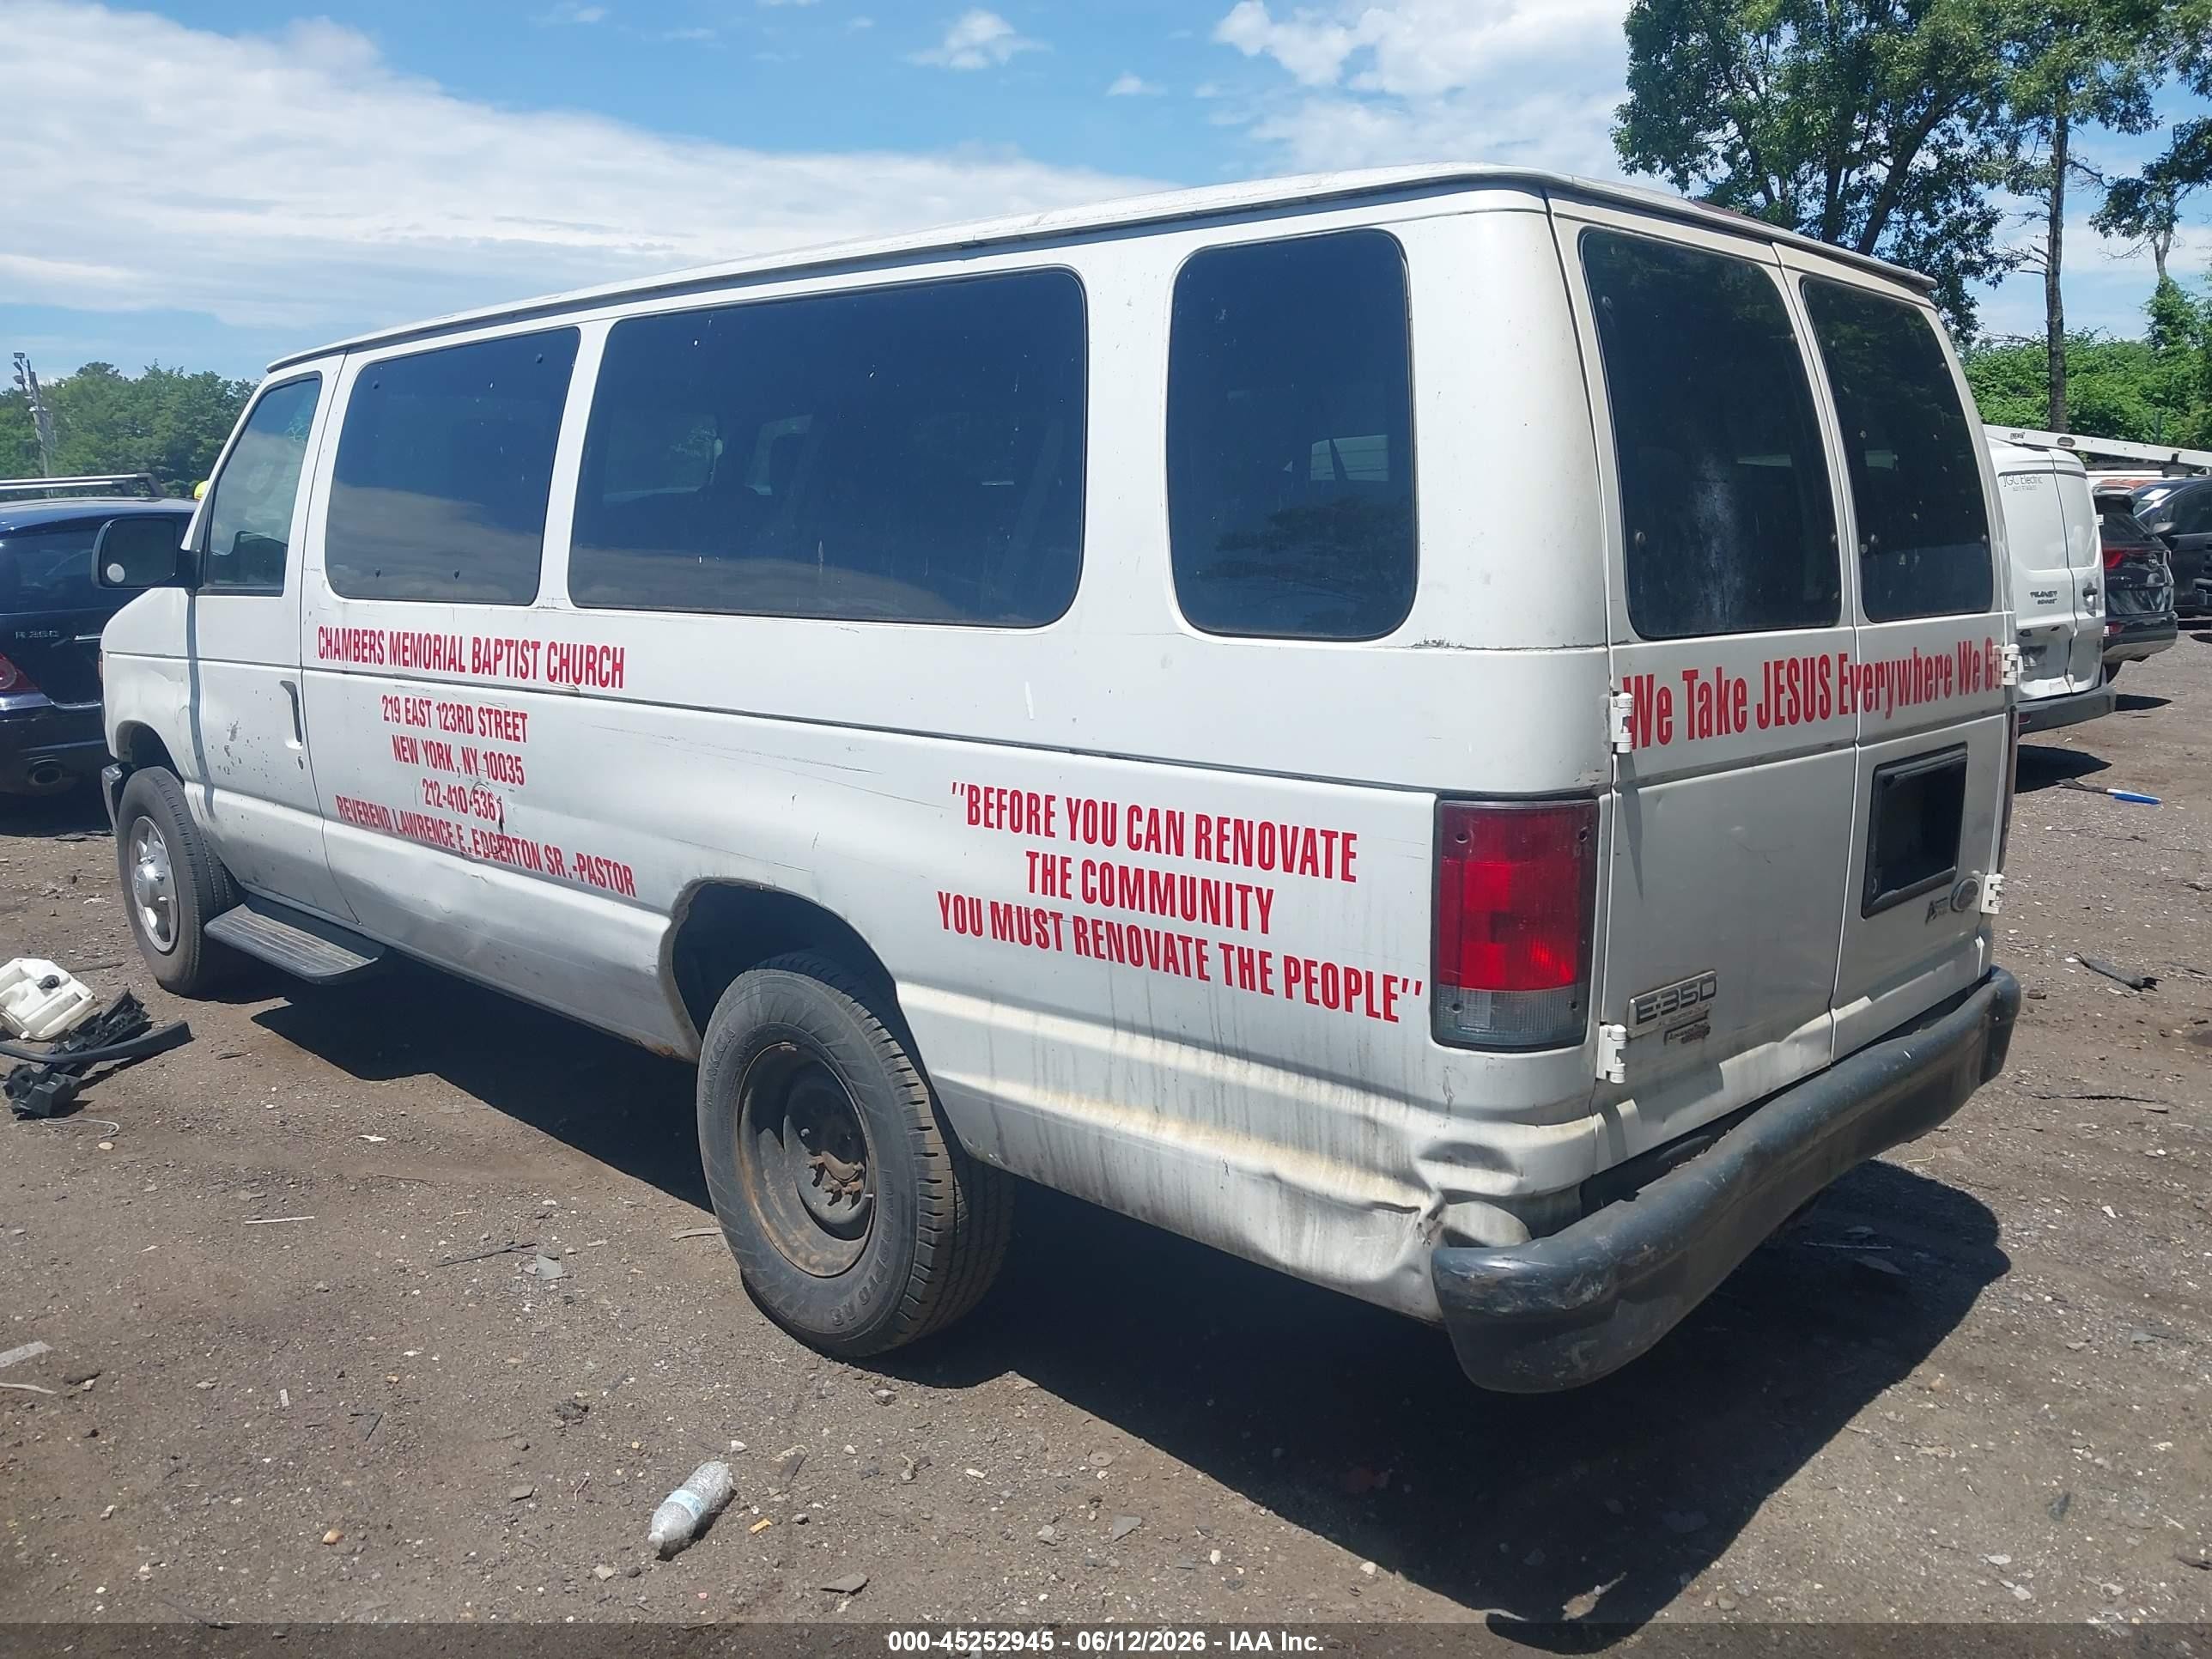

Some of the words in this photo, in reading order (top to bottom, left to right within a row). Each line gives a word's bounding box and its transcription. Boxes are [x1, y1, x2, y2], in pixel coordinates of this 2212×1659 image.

[318, 626, 385, 665] CHAMBERS
[389, 631, 465, 673] MEMORIAL
[471, 636, 540, 680] BAPTIST
[546, 641, 625, 688] CHURCH
[1623, 673, 1673, 750] We
[1682, 666, 1747, 740] Take
[1757, 653, 1831, 730] JESUS
[1838, 647, 1953, 719] Everywhere
[1957, 640, 1981, 696] We
[381, 695, 401, 723] 219
[405, 697, 432, 728] EAST
[436, 702, 474, 735] 123RD
[478, 708, 528, 743] STREET
[392, 734, 418, 764] NEW
[463, 748, 479, 775] NY
[483, 751, 526, 786] 10035
[336, 795, 392, 831] REVEREND
[396, 809, 455, 848] LAWRENCE
[471, 828, 543, 872] EDGERTON
[422, 779, 506, 824] 212-410-5361
[1066, 797, 1117, 848] YOU
[1127, 804, 1185, 857] CAN
[1195, 814, 1358, 883] RENOVATE
[1026, 850, 1073, 900] THE
[1081, 859, 1275, 935] COMMUNITY
[938, 890, 983, 938] YOU
[990, 901, 1064, 952] MUST
[1073, 915, 1211, 981] RENOVATE
[1218, 942, 1274, 995] THE
